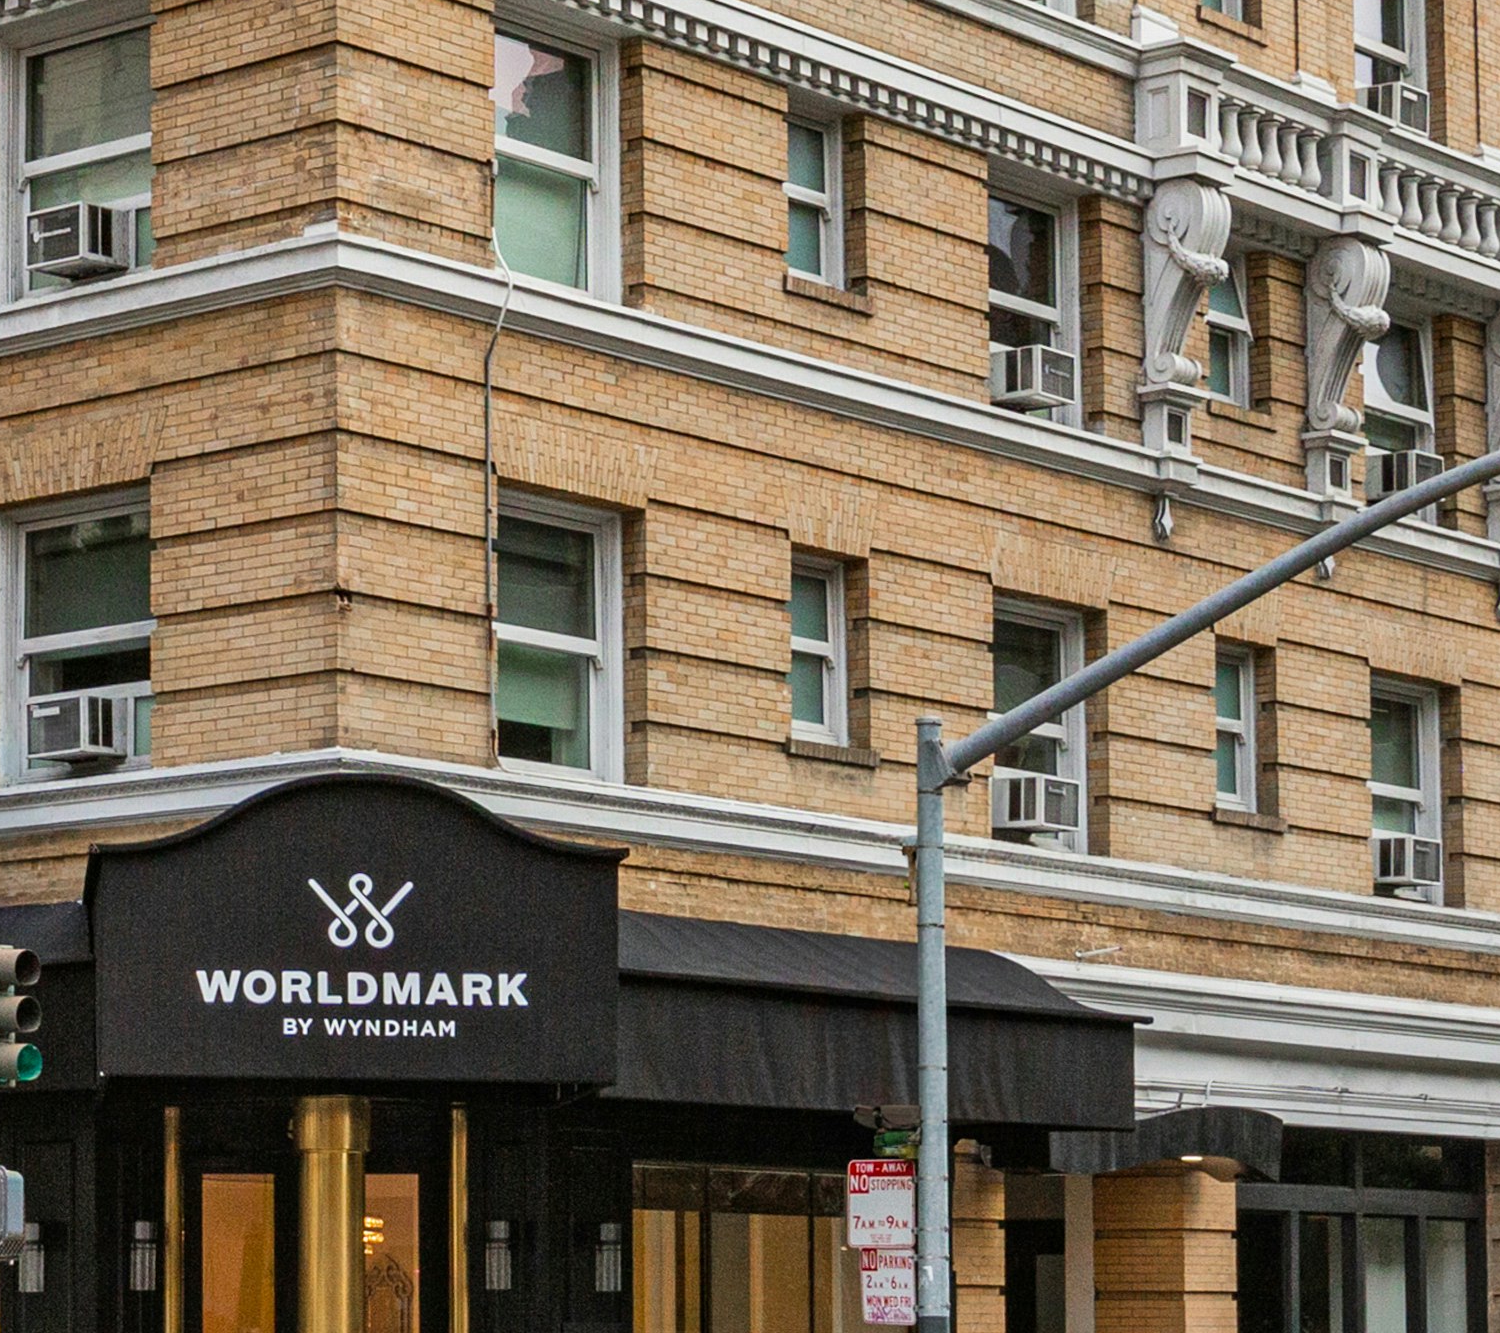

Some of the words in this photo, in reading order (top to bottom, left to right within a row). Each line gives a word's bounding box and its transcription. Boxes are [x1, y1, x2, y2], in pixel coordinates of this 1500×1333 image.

[196, 969, 528, 1007] WORLDMARK
[282, 1017, 313, 1036] BY
[323, 1018, 456, 1037] WYNDHAM
[855, 1163, 875, 1173] TOW
[881, 1163, 908, 1173] AWAY
[850, 1175, 868, 1191] NO
[870, 1179, 912, 1191] STOPPING
[862, 1250, 876, 1270] NO
[879, 1255, 912, 1269] PARKING
